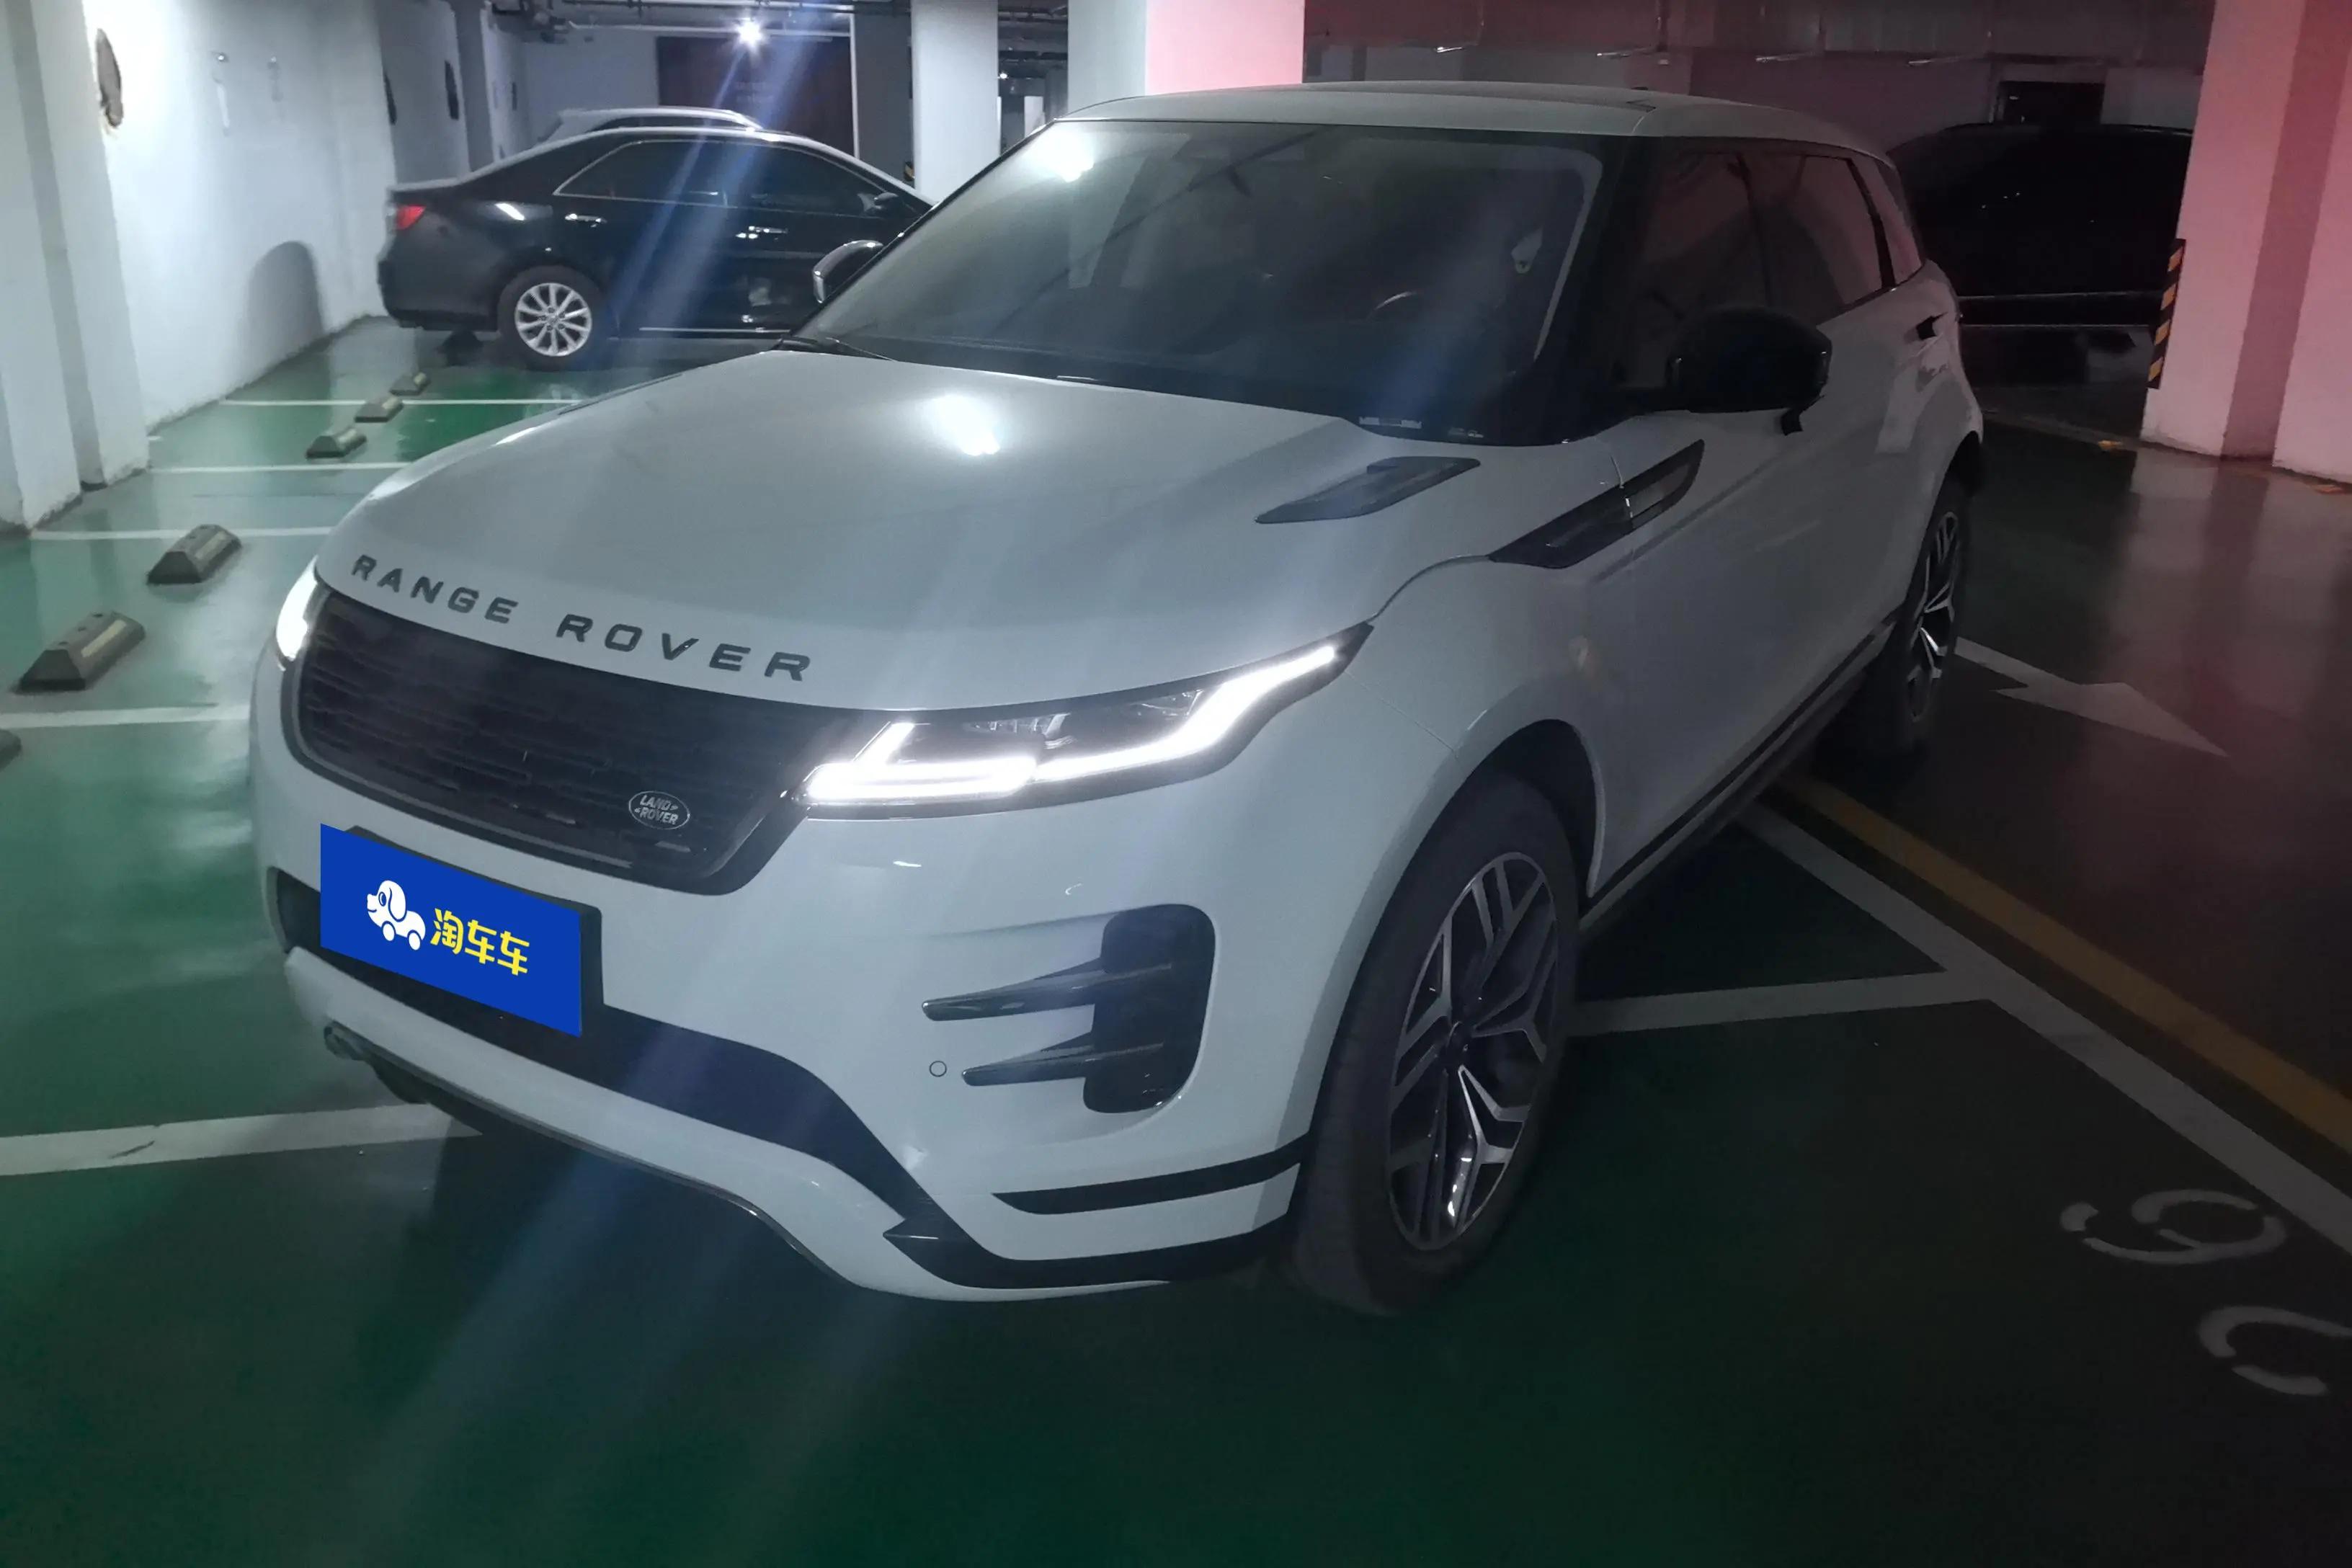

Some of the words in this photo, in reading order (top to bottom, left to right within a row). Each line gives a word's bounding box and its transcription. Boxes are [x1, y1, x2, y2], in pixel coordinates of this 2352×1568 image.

[351, 553, 520, 625] RANGE
[556, 613, 811, 682] ROVER
[640, 795, 671, 811] LAND
[639, 807, 678, 825] ROVER
